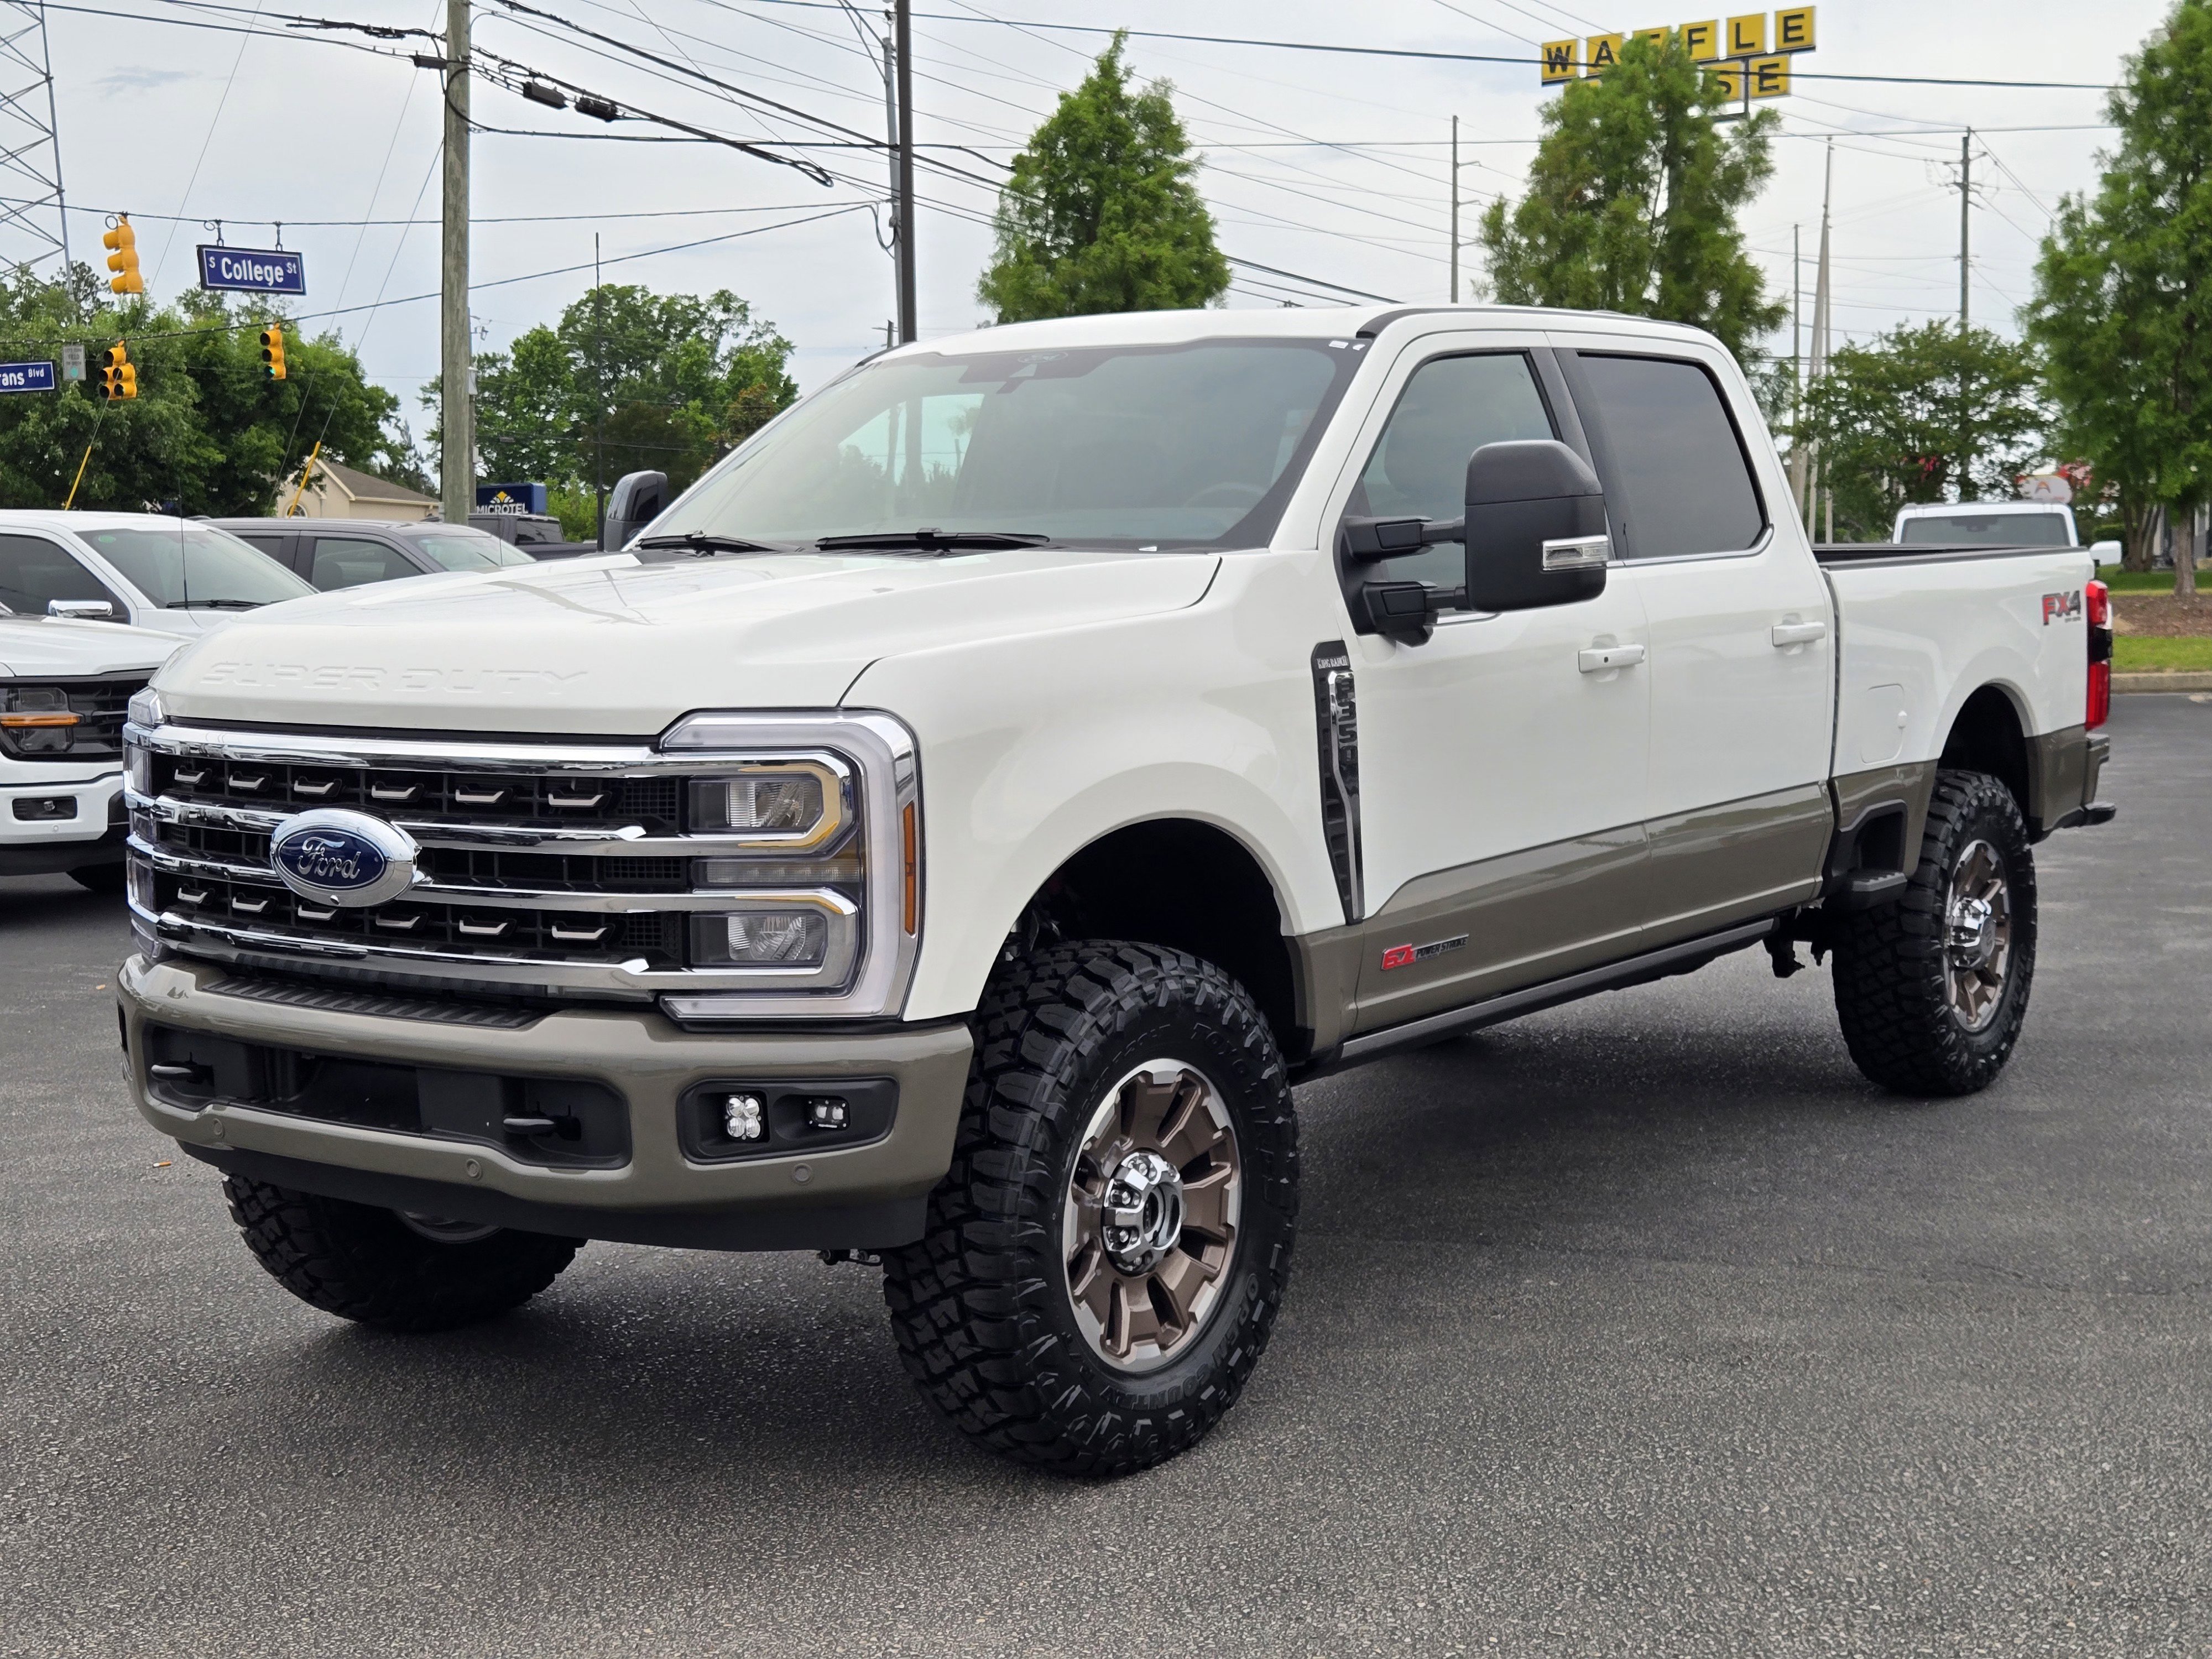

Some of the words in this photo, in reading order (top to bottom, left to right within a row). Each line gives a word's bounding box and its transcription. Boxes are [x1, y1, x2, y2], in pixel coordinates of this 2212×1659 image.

[1547, 13, 1805, 74] WAFLE
[208, 256, 216, 268] S
[222, 257, 284, 286] College
[286, 262, 297, 274] St
[0, 372, 25, 386] ans
[28, 366, 44, 378] Blvd
[476, 503, 528, 514] MICROTEL
[2043, 590, 2081, 625] FX4
[200, 662, 387, 691] SUPER
[392, 669, 588, 695] DUTY
[297, 837, 362, 879] Ford
